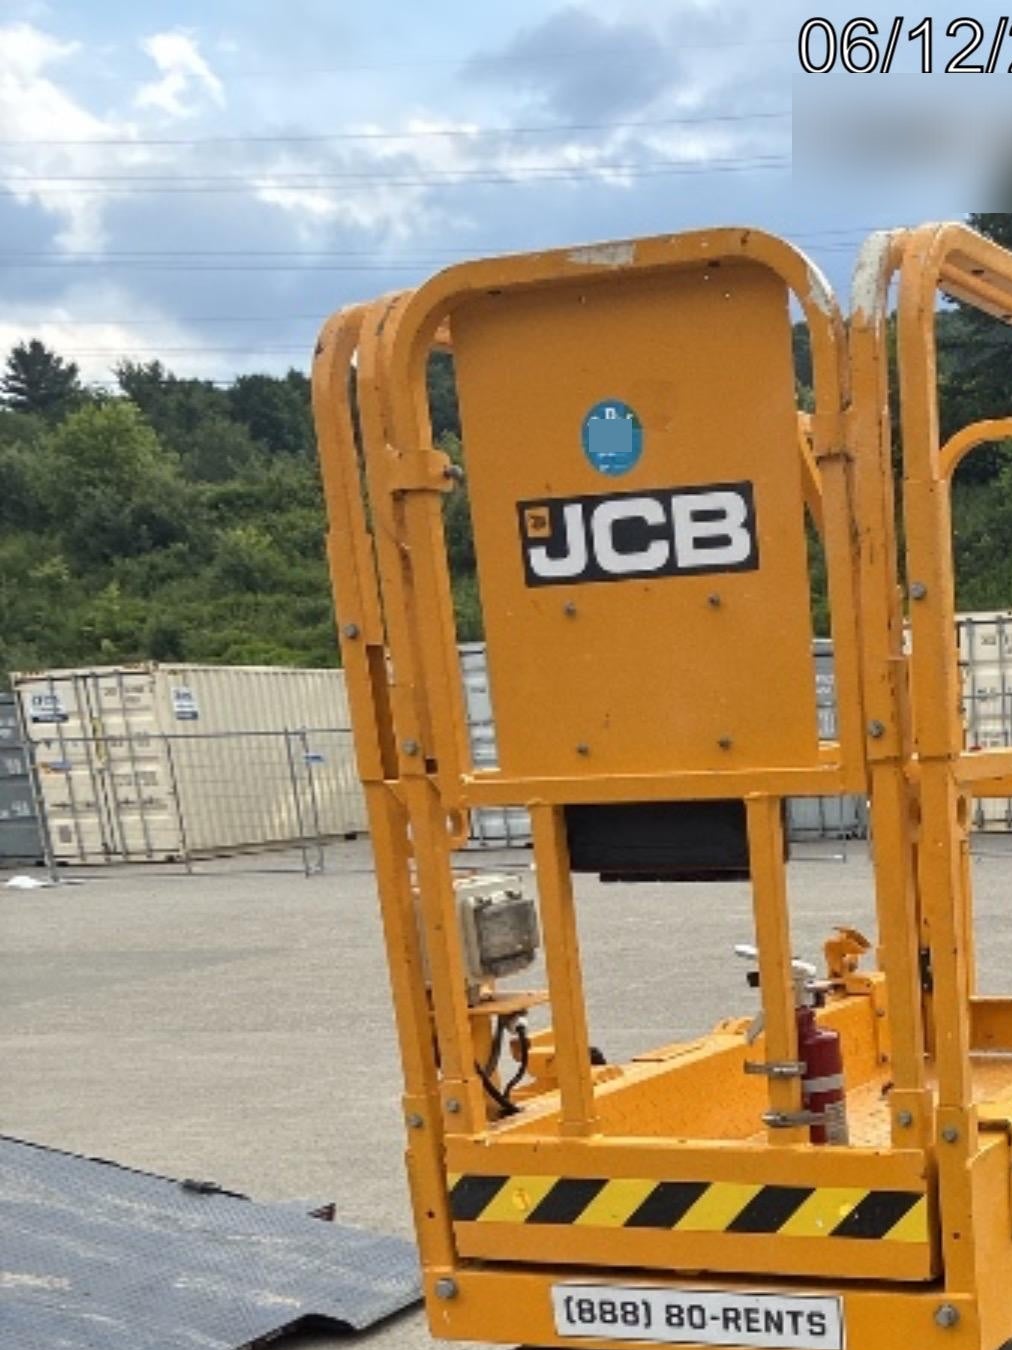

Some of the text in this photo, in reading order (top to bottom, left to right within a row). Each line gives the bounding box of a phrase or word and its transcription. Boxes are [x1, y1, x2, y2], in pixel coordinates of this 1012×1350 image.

[528, 491, 751, 577] JCB
[563, 1295, 828, 1336] (888) 80-RENTS
